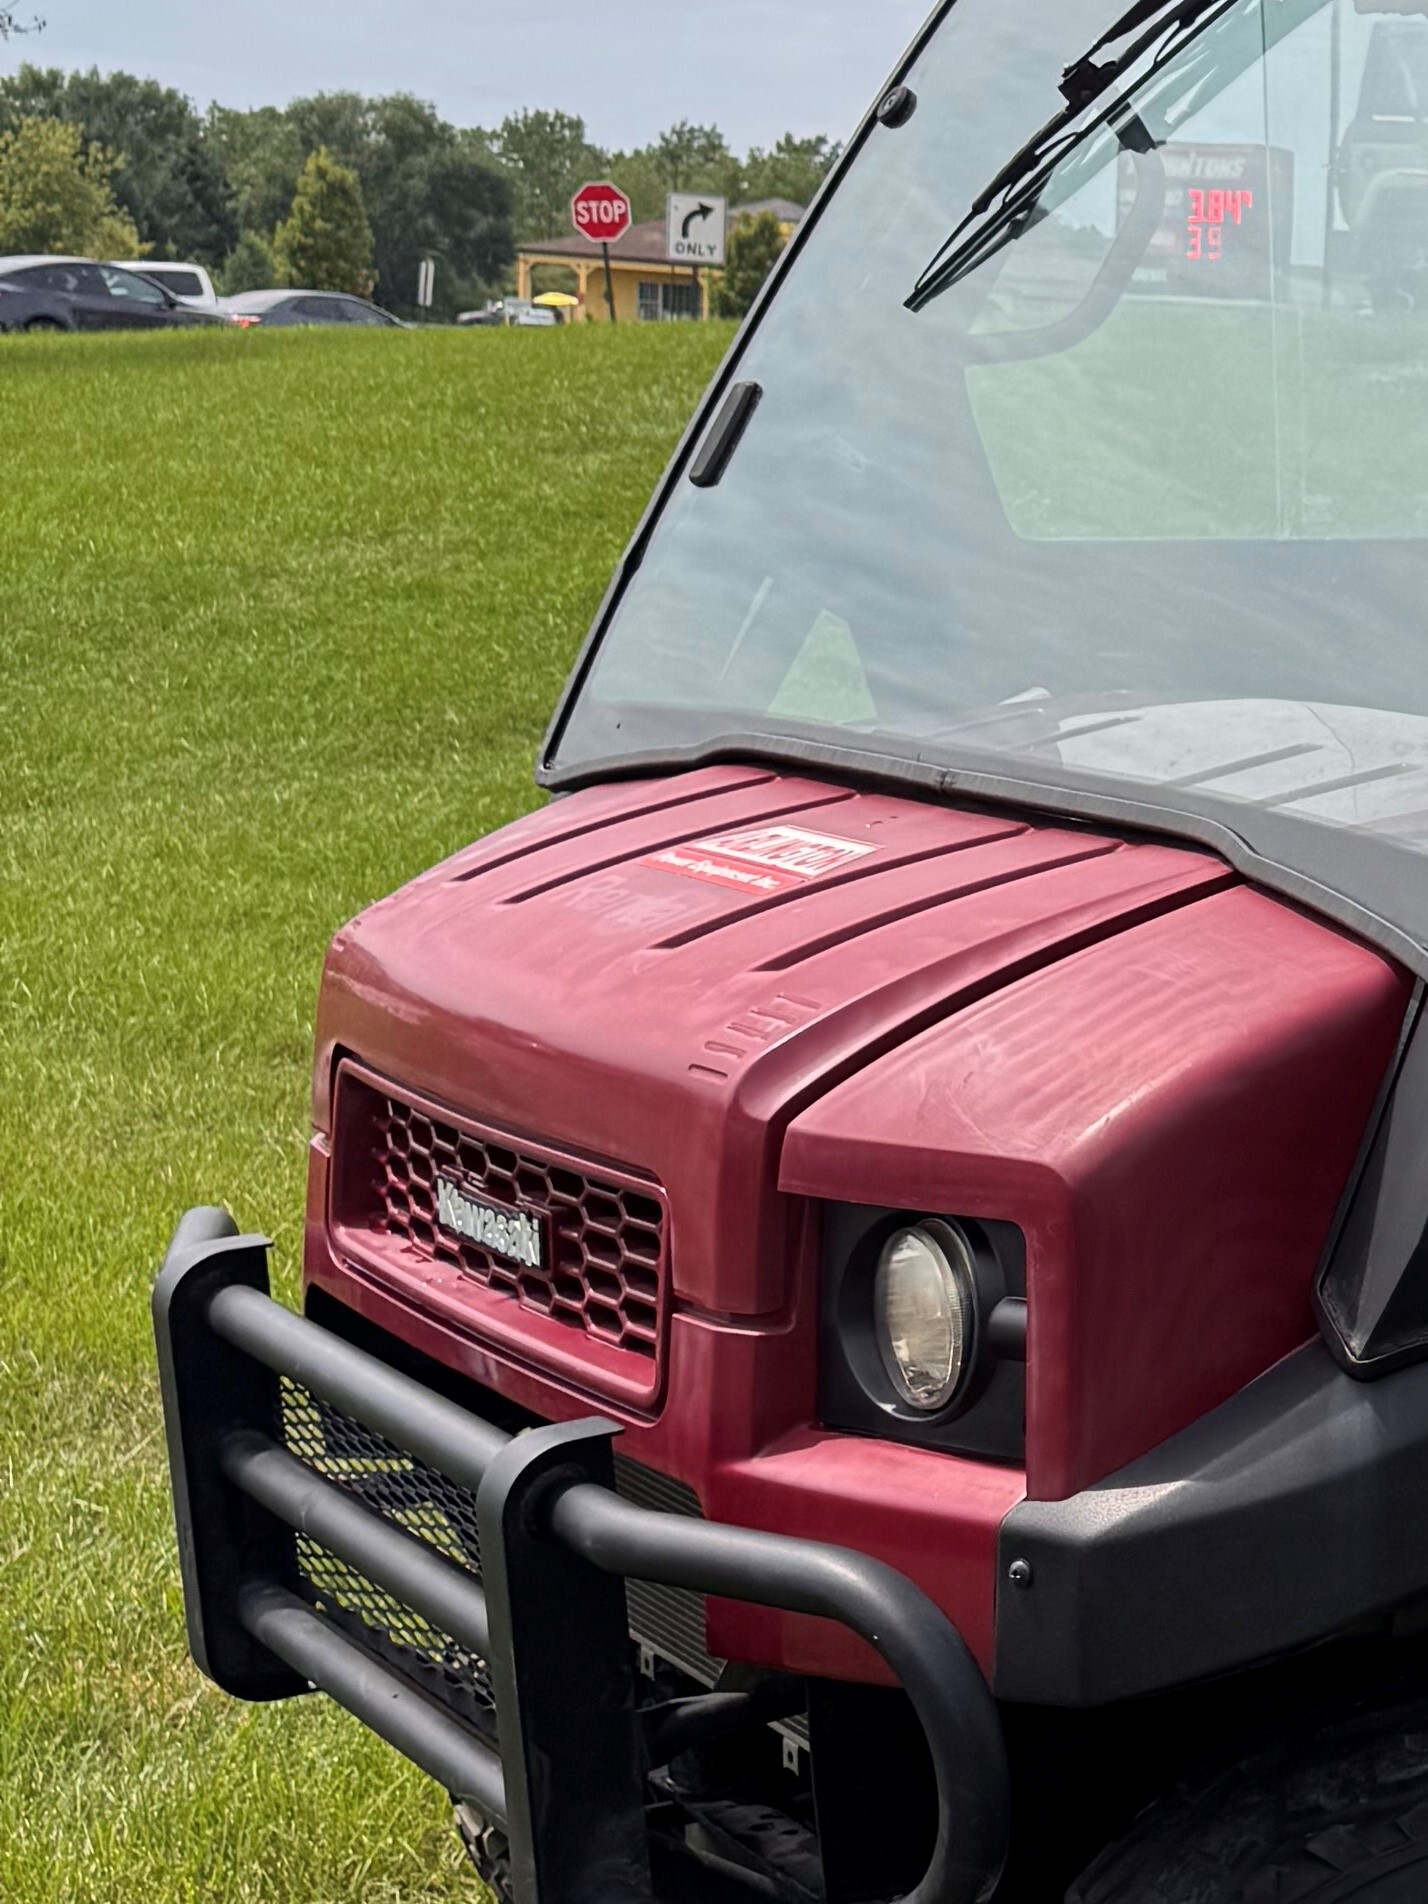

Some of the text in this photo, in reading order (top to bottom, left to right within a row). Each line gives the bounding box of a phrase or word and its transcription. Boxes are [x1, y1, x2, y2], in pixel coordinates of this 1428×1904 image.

[576, 200, 627, 224] STOP
[675, 241, 717, 257] ONLY
[437, 1178, 540, 1267] Kawasaki
